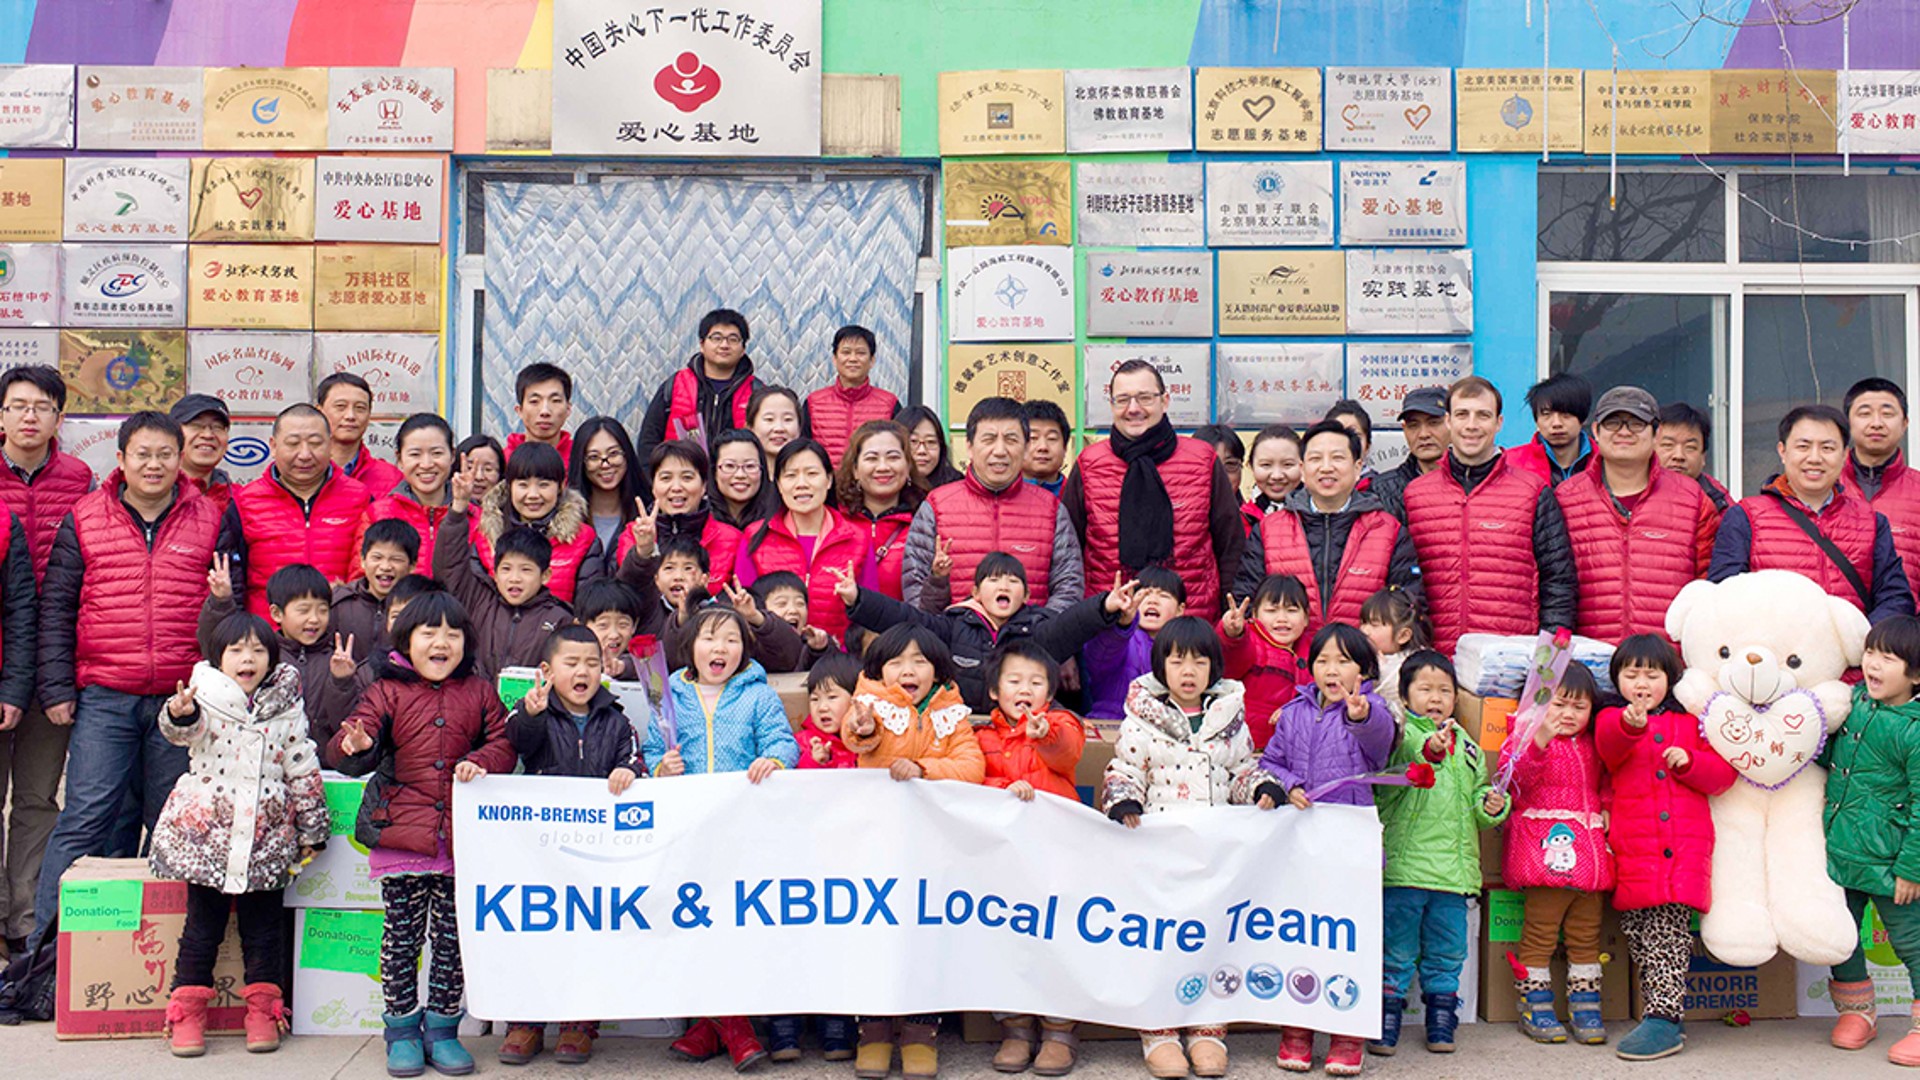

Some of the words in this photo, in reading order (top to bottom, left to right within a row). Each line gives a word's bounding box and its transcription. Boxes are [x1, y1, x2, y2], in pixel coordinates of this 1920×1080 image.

[565, 7, 811, 73] 中国关心下一代工作委员会
[91, 86, 191, 113] 爱心教育基地
[336, 75, 445, 114] 车友爱心活动基地
[1074, 84, 1182, 101] 北京怀柔佛教慈善会
[1204, 76, 1314, 123] 北京科技大学机械工程学院
[1352, 89, 1424, 102] 志愿服务基地
[1093, 105, 1165, 122] 佛教教育基地
[1748, 113, 1801, 125] 保险学院
[1850, 113, 1920, 130] 爱心教育
[616, 121, 760, 144] 爱心基地
[1210, 128, 1308, 142] 志愿服务基地
[1734, 132, 1814, 143] 社会实践基地
[323, 171, 434, 187] 中共中央办公厅信息中心
[1, 191, 31, 207] 基地
[1361, 197, 1444, 216] 爱心基地
[333, 199, 422, 221] 爱心基地
[1219, 202, 1319, 214] 中国狮子联会
[75, 223, 178, 234] 爱心教育基地
[214, 220, 287, 231] 社会实践基地
[1219, 215, 1320, 228] 北京狮友义工基地
[1371, 263, 1447, 275] 天津市作家协会
[345, 271, 411, 288] 万科社区
[202, 287, 300, 304] 爱心教育基地
[1100, 287, 1200, 303] 爱心教育基地
[1362, 279, 1459, 298] 实践基地
[328, 290, 427, 306] 志愿者爱心基地
[73, 302, 174, 312] 青年志愿者爱心服务基地
[976, 316, 1045, 328] 爱心教育基地
[204, 346, 296, 372] 国际名品灯饰网
[1360, 354, 1460, 365] 中国经济景气监测中心
[953, 349, 1071, 395] 德馨堂艺术创意工作室
[1360, 367, 1460, 377] 中国统计信息服务中心
[1166, 383, 1192, 395] 阳村
[1227, 379, 1333, 393] 志愿者服务基地
[215, 388, 285, 401] 爱心教育基地
[478, 805, 607, 823] KNORR-BREMSE
[539, 830, 604, 847] global
[613, 832, 654, 845] care
[116, 919, 138, 928] Food
[475, 885, 652, 933] KBNK
[672, 882, 713, 930] &
[735, 878, 899, 928] KBDX
[917, 879, 1058, 941] Local
[1077, 897, 1207, 954] Care
[1227, 900, 1357, 953] Team
[348, 945, 376, 957] Flour
[1685, 976, 1758, 993] KNORR
[84, 975, 242, 1011] 野心界
[1684, 993, 1758, 1010] BREMSE
